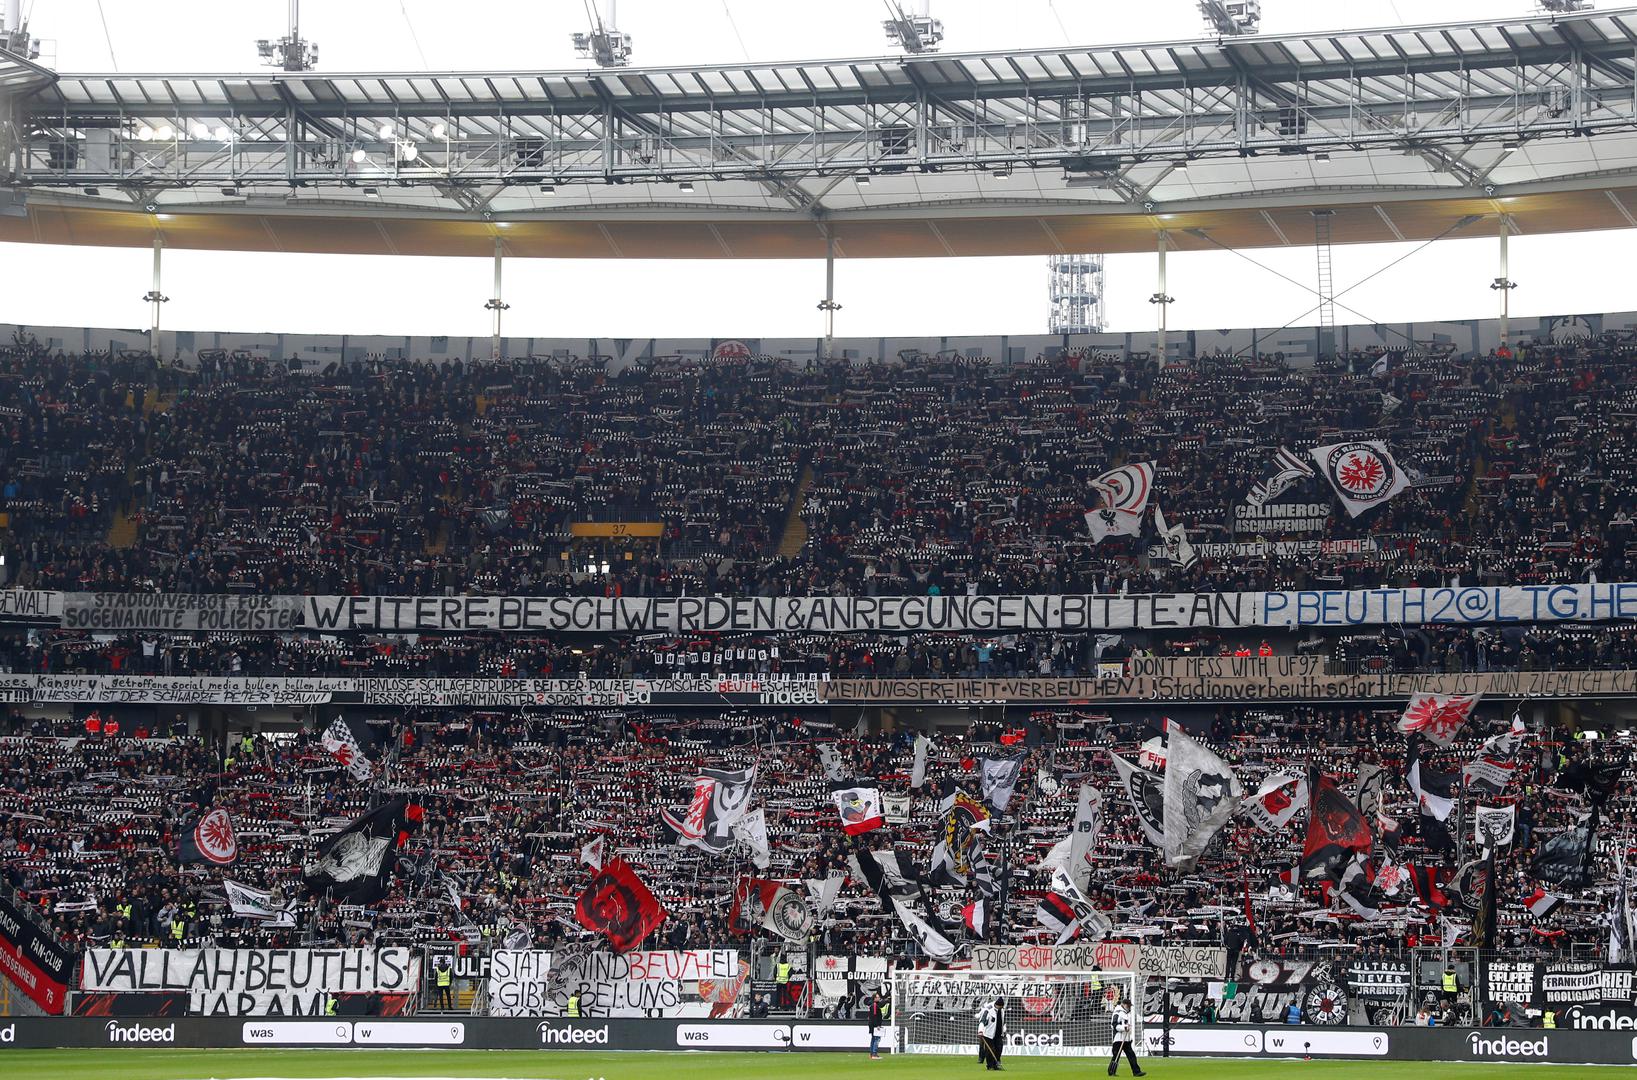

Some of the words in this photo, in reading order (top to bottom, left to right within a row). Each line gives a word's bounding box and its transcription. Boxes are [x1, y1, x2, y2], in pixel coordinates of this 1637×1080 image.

[1330, 453, 1342, 467] EFC
[1235, 503, 1330, 519] CALIMEROS
[612, 524, 626, 535] 37
[94, 592, 230, 609] STADIONVERBOT
[238, 594, 272, 609] FÜR
[65, 608, 186, 628] SOGENANNTE
[311, 597, 488, 629] WEITERE
[499, 597, 776, 630] BESCHWERDEN
[1061, 594, 1177, 628] BITTE
[1189, 592, 1242, 625] AN
[1134, 657, 1178, 677] DON'T
[1186, 657, 1222, 677] MESS
[1231, 656, 1268, 677] WITH
[1278, 656, 1319, 676] UF97
[208, 680, 238, 689] media
[245, 679, 279, 690] bullen
[534, 680, 555, 691] BEI
[559, 680, 584, 691] DER
[1490, 673, 1520, 693] NUN
[1530, 672, 1601, 693] ZIEMLICH
[34, 690, 46, 701] IN
[48, 690, 95, 701] HESSEN
[99, 691, 117, 701] IST
[120, 690, 148, 702] DER
[224, 691, 270, 703] PETER
[825, 681, 1000, 699] MEINUNGSFREIHEIT
[89, 950, 237, 990] VALLAH
[245, 950, 363, 990] BEUTH
[1249, 959, 1315, 984] 97
[1354, 961, 1407, 971] ULTRAS
[1516, 962, 1535, 972] DER
[848, 972, 885, 980] GUARDIA
[1357, 974, 1402, 983] NEVER
[1488, 972, 1534, 982] GRUPPE
[1546, 973, 1600, 988] FRANKFURT
[1601, 971, 1632, 989] RIED
[1488, 982, 1533, 992] STADION
[1601, 988, 1631, 999] GEBIET
[46, 988, 55, 1004] 75
[626, 982, 677, 1008] UNS
[1488, 991, 1533, 1003] VERBOT
[1546, 988, 1601, 1003] HOOLIGANS
[109, 1022, 175, 1043] indeed
[250, 1029, 274, 1039] was
[361, 1029, 372, 1039] w
[541, 1023, 609, 1044] indeed
[684, 1030, 709, 1041] was
[800, 1032, 811, 1041] w
[1272, 1037, 1284, 1047] w
[1471, 1035, 1548, 1056] indeed
